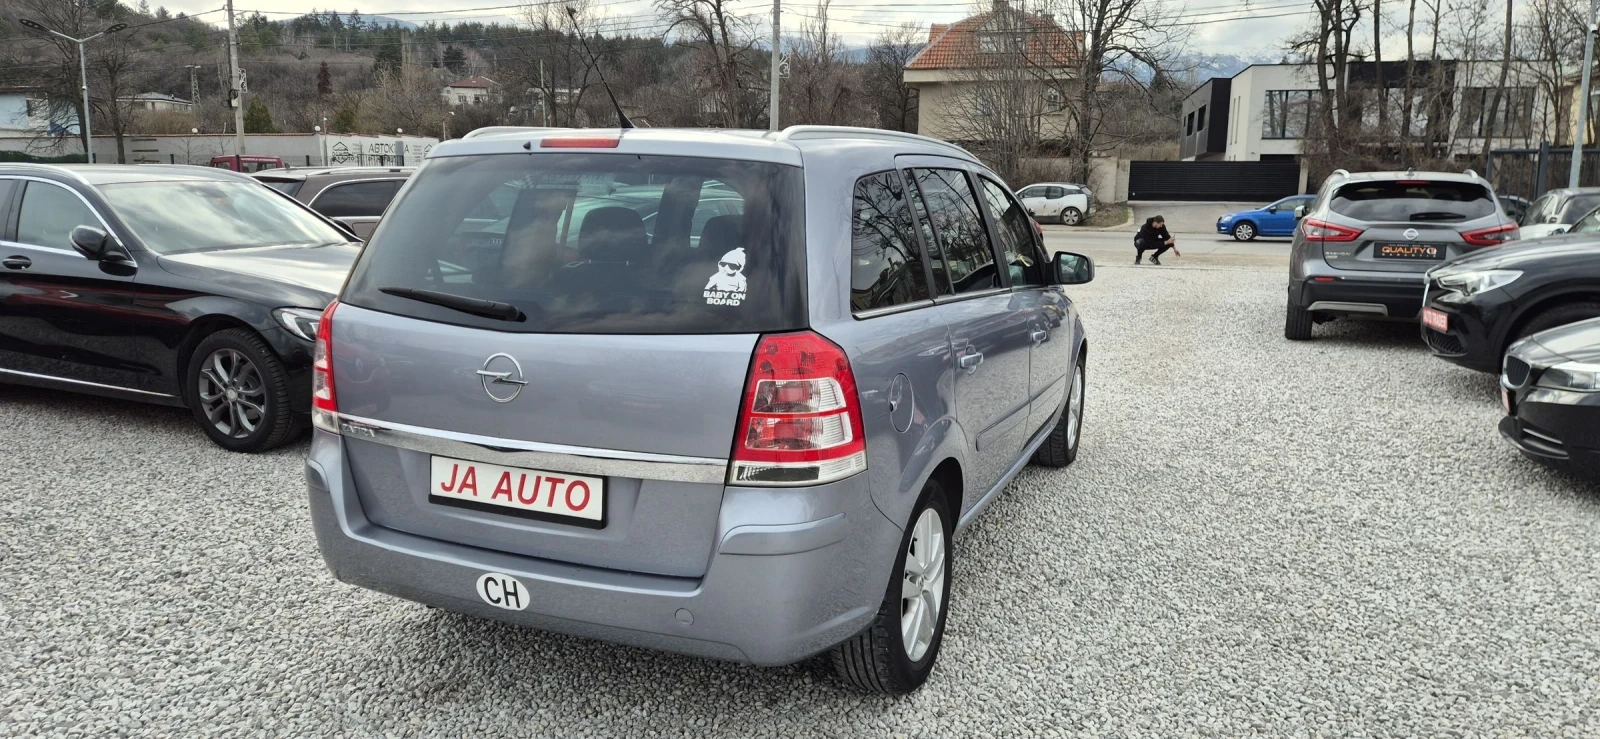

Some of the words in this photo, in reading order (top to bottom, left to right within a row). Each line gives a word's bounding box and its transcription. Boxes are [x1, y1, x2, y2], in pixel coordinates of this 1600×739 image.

[1381, 246, 1426, 254] QUALITY
[706, 297, 741, 306] BOARD
[440, 463, 478, 497] JA
[491, 471, 591, 512] AUTO
[484, 576, 521, 609] CH
